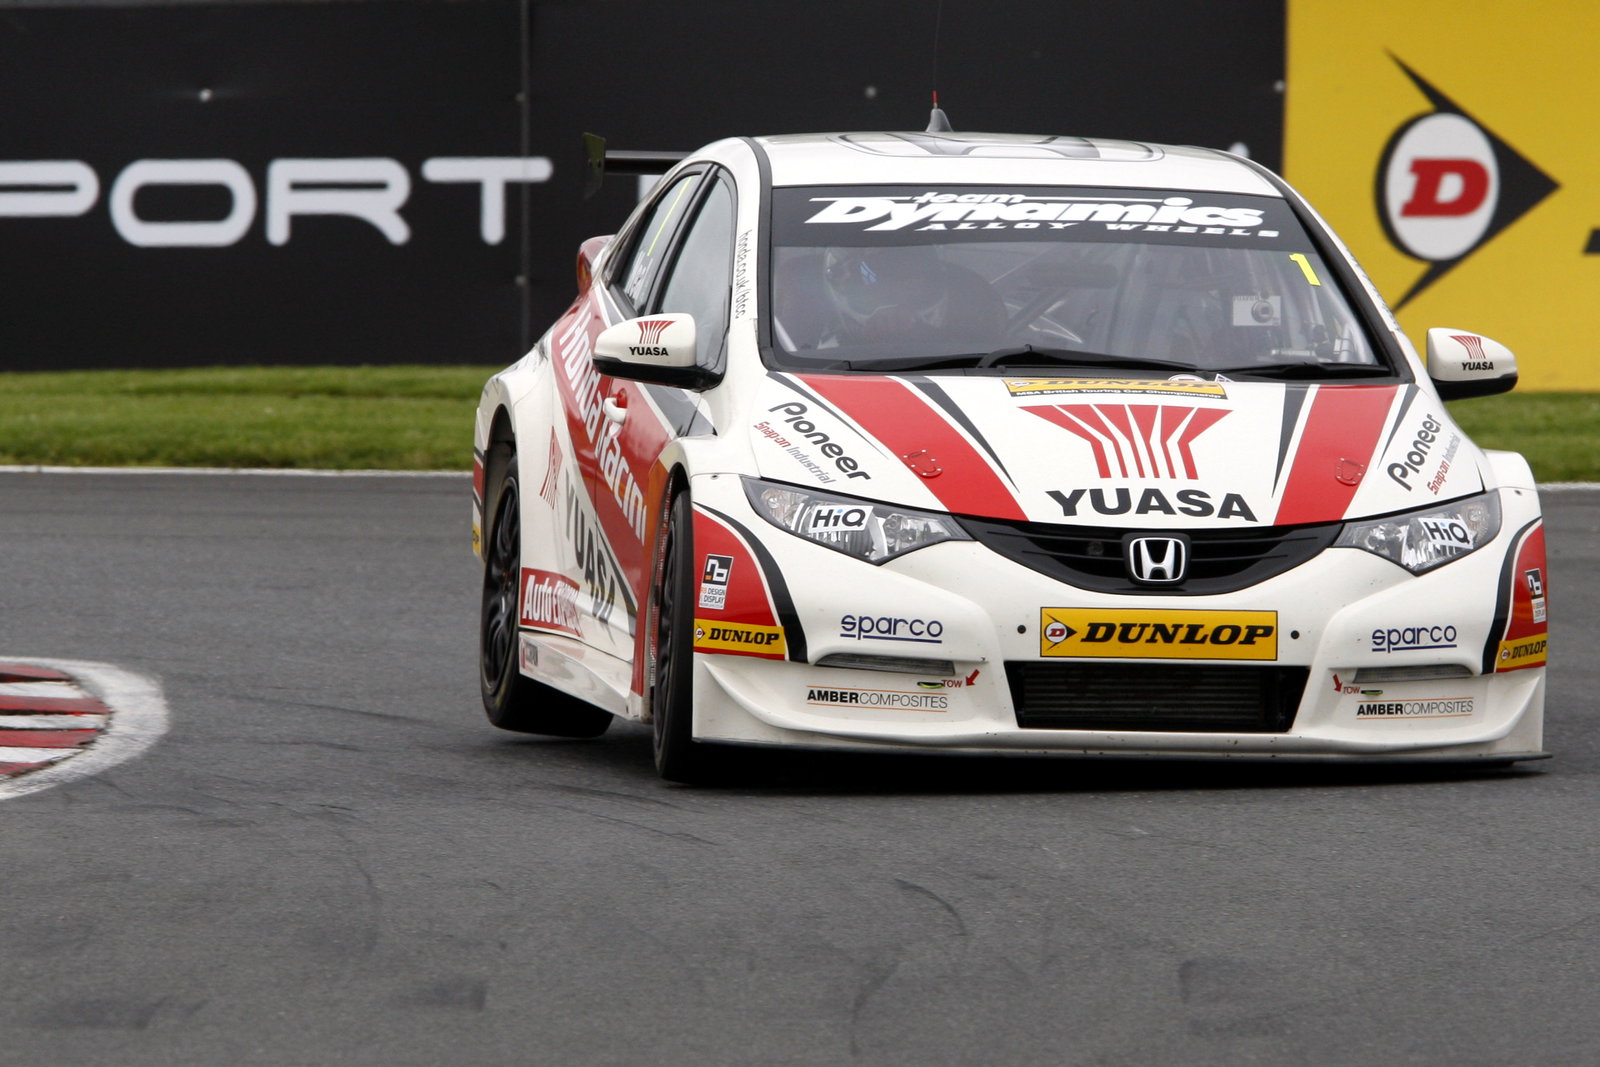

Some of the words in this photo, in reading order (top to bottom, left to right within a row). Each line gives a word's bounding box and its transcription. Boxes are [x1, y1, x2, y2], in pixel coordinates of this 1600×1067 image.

[912, 191, 1026, 205] team
[804, 194, 1264, 232] Dynamics
[915, 222, 1078, 232] ALLOY
[1105, 223, 1280, 238] WHEELS
[1289, 253, 1321, 286] 1
[629, 346, 669, 356] YUASA
[559, 300, 603, 444] Honda
[1461, 361, 1495, 372] YUASA
[1043, 380, 1218, 389] DUNLOP
[1145, 390, 1222, 399] Championship
[768, 402, 871, 481] Pioneer
[1387, 413, 1443, 493] Pioneer
[786, 446, 837, 485] Industrial
[1045, 487, 1259, 523] YUASA
[812, 508, 866, 528] HiQ
[1423, 521, 1470, 545] HiQ
[522, 574, 553, 623] Auto
[703, 595, 725, 604] DISPLAY
[708, 627, 780, 646] DUNLOP
[840, 614, 944, 641] sparco
[1080, 622, 1275, 646] DUNLOP
[1371, 625, 1457, 653] sparco
[1511, 639, 1547, 660] DUNLOP
[941, 678, 963, 689] TOW
[1343, 685, 1361, 695] TOW
